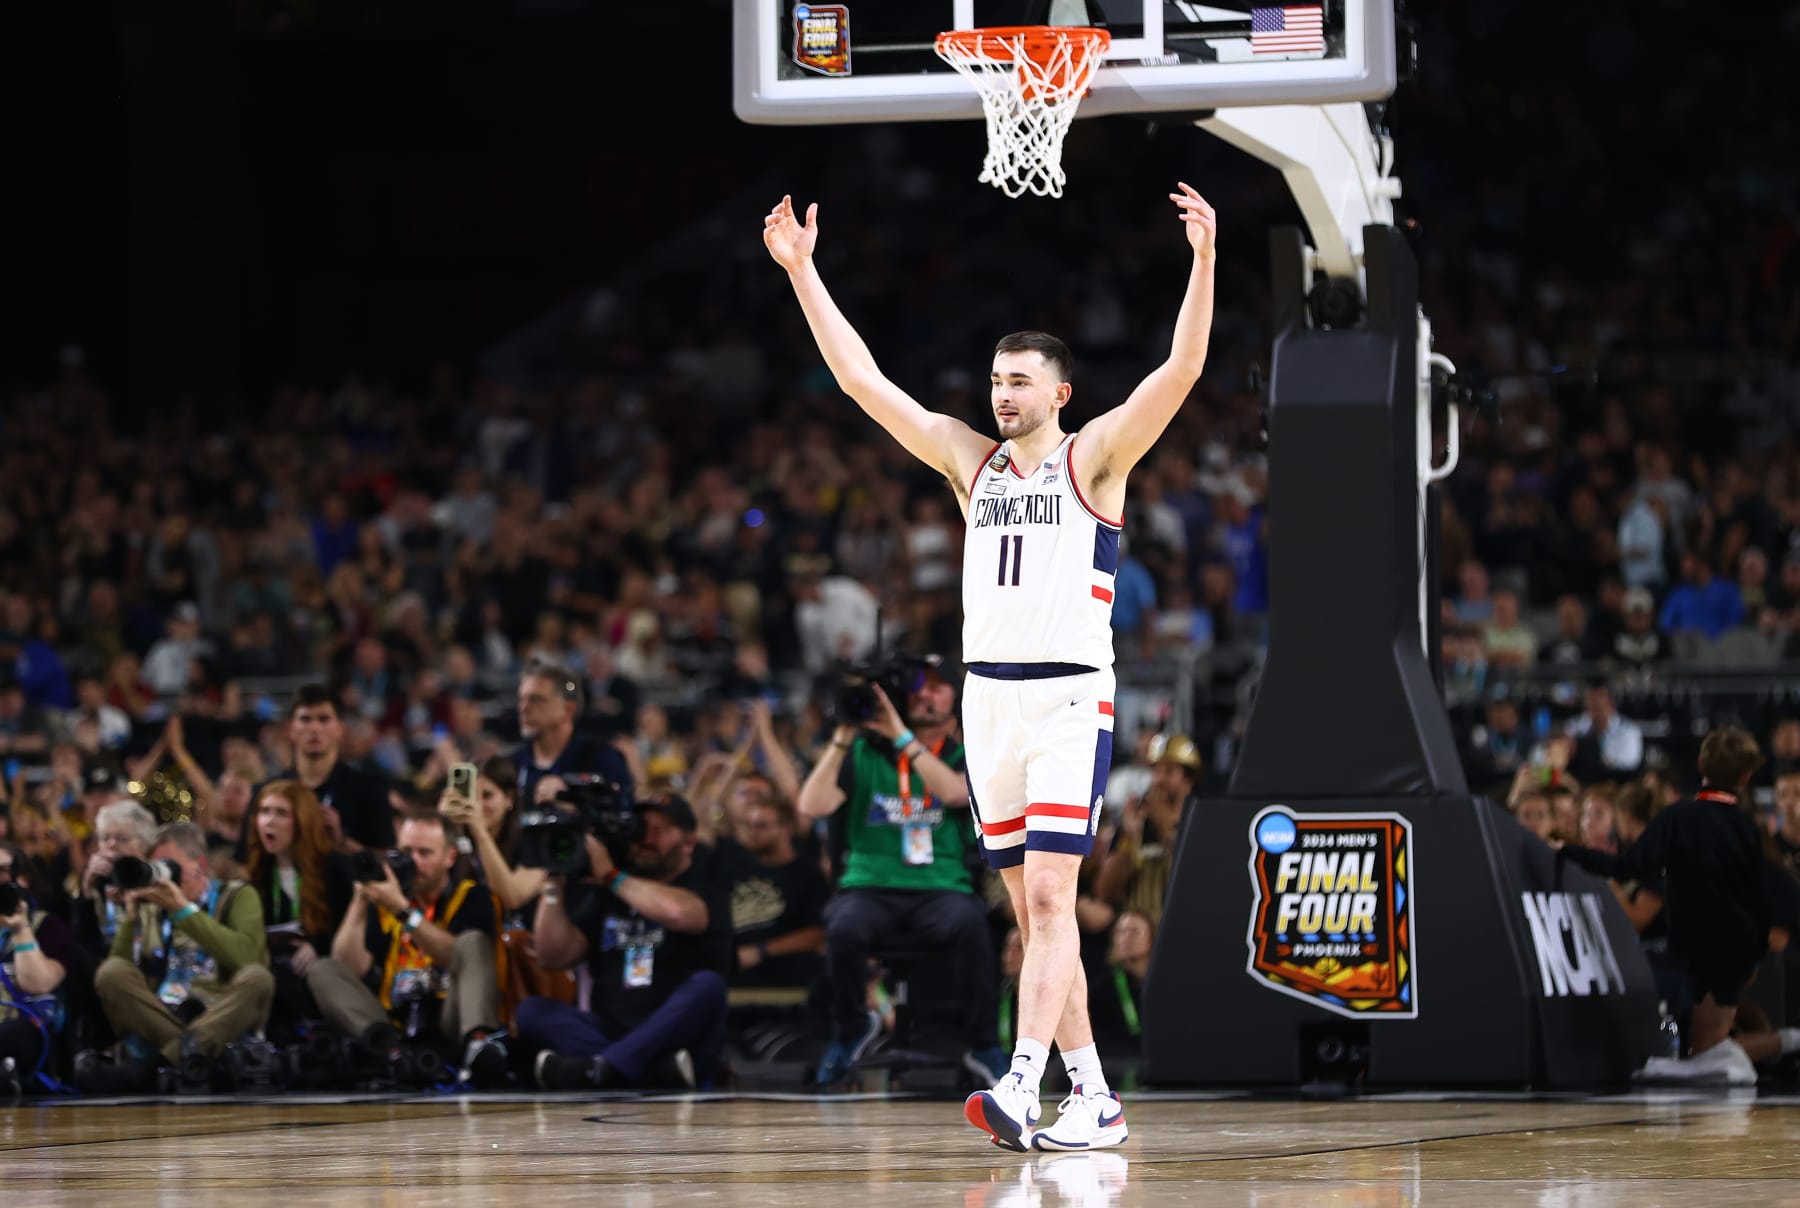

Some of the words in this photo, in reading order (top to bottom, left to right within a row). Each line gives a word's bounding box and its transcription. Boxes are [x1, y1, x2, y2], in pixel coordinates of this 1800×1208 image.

[974, 494, 1063, 528] CONNECTICUT
[998, 535, 1023, 586] 11
[1302, 833, 1335, 848] 2024
[1336, 833, 1377, 848] MEN'S
[1275, 852, 1379, 893] FINAL
[1275, 893, 1377, 934] FOUR
[1293, 943, 1361, 957] PHOENIX
[1521, 891, 1626, 997] NCAA
